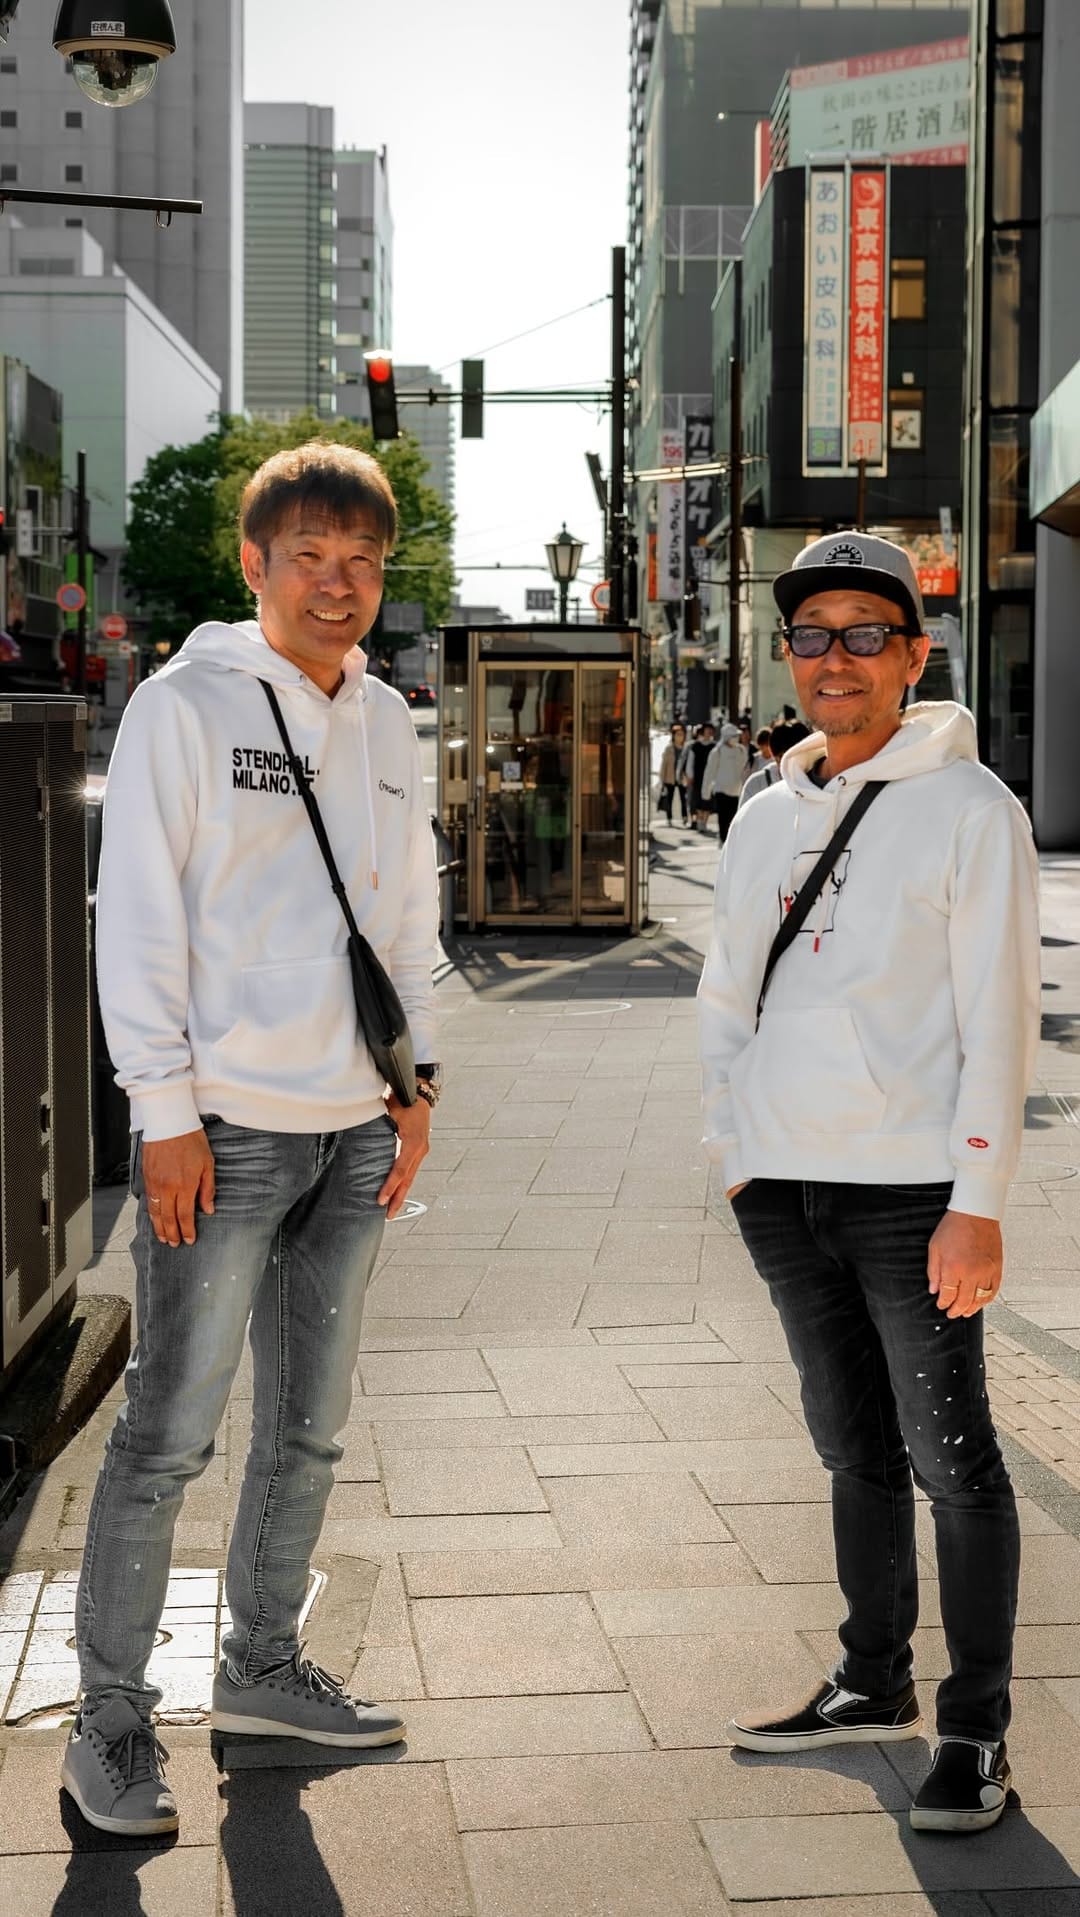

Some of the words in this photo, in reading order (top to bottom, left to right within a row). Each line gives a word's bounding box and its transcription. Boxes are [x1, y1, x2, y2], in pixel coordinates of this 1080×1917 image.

[814, 180, 838, 360] あおい皮ふ科
[854, 207, 880, 359] 東京美容外科
[232, 747, 320, 775] STENDHL.
[232, 768, 314, 796] MILANO.T
